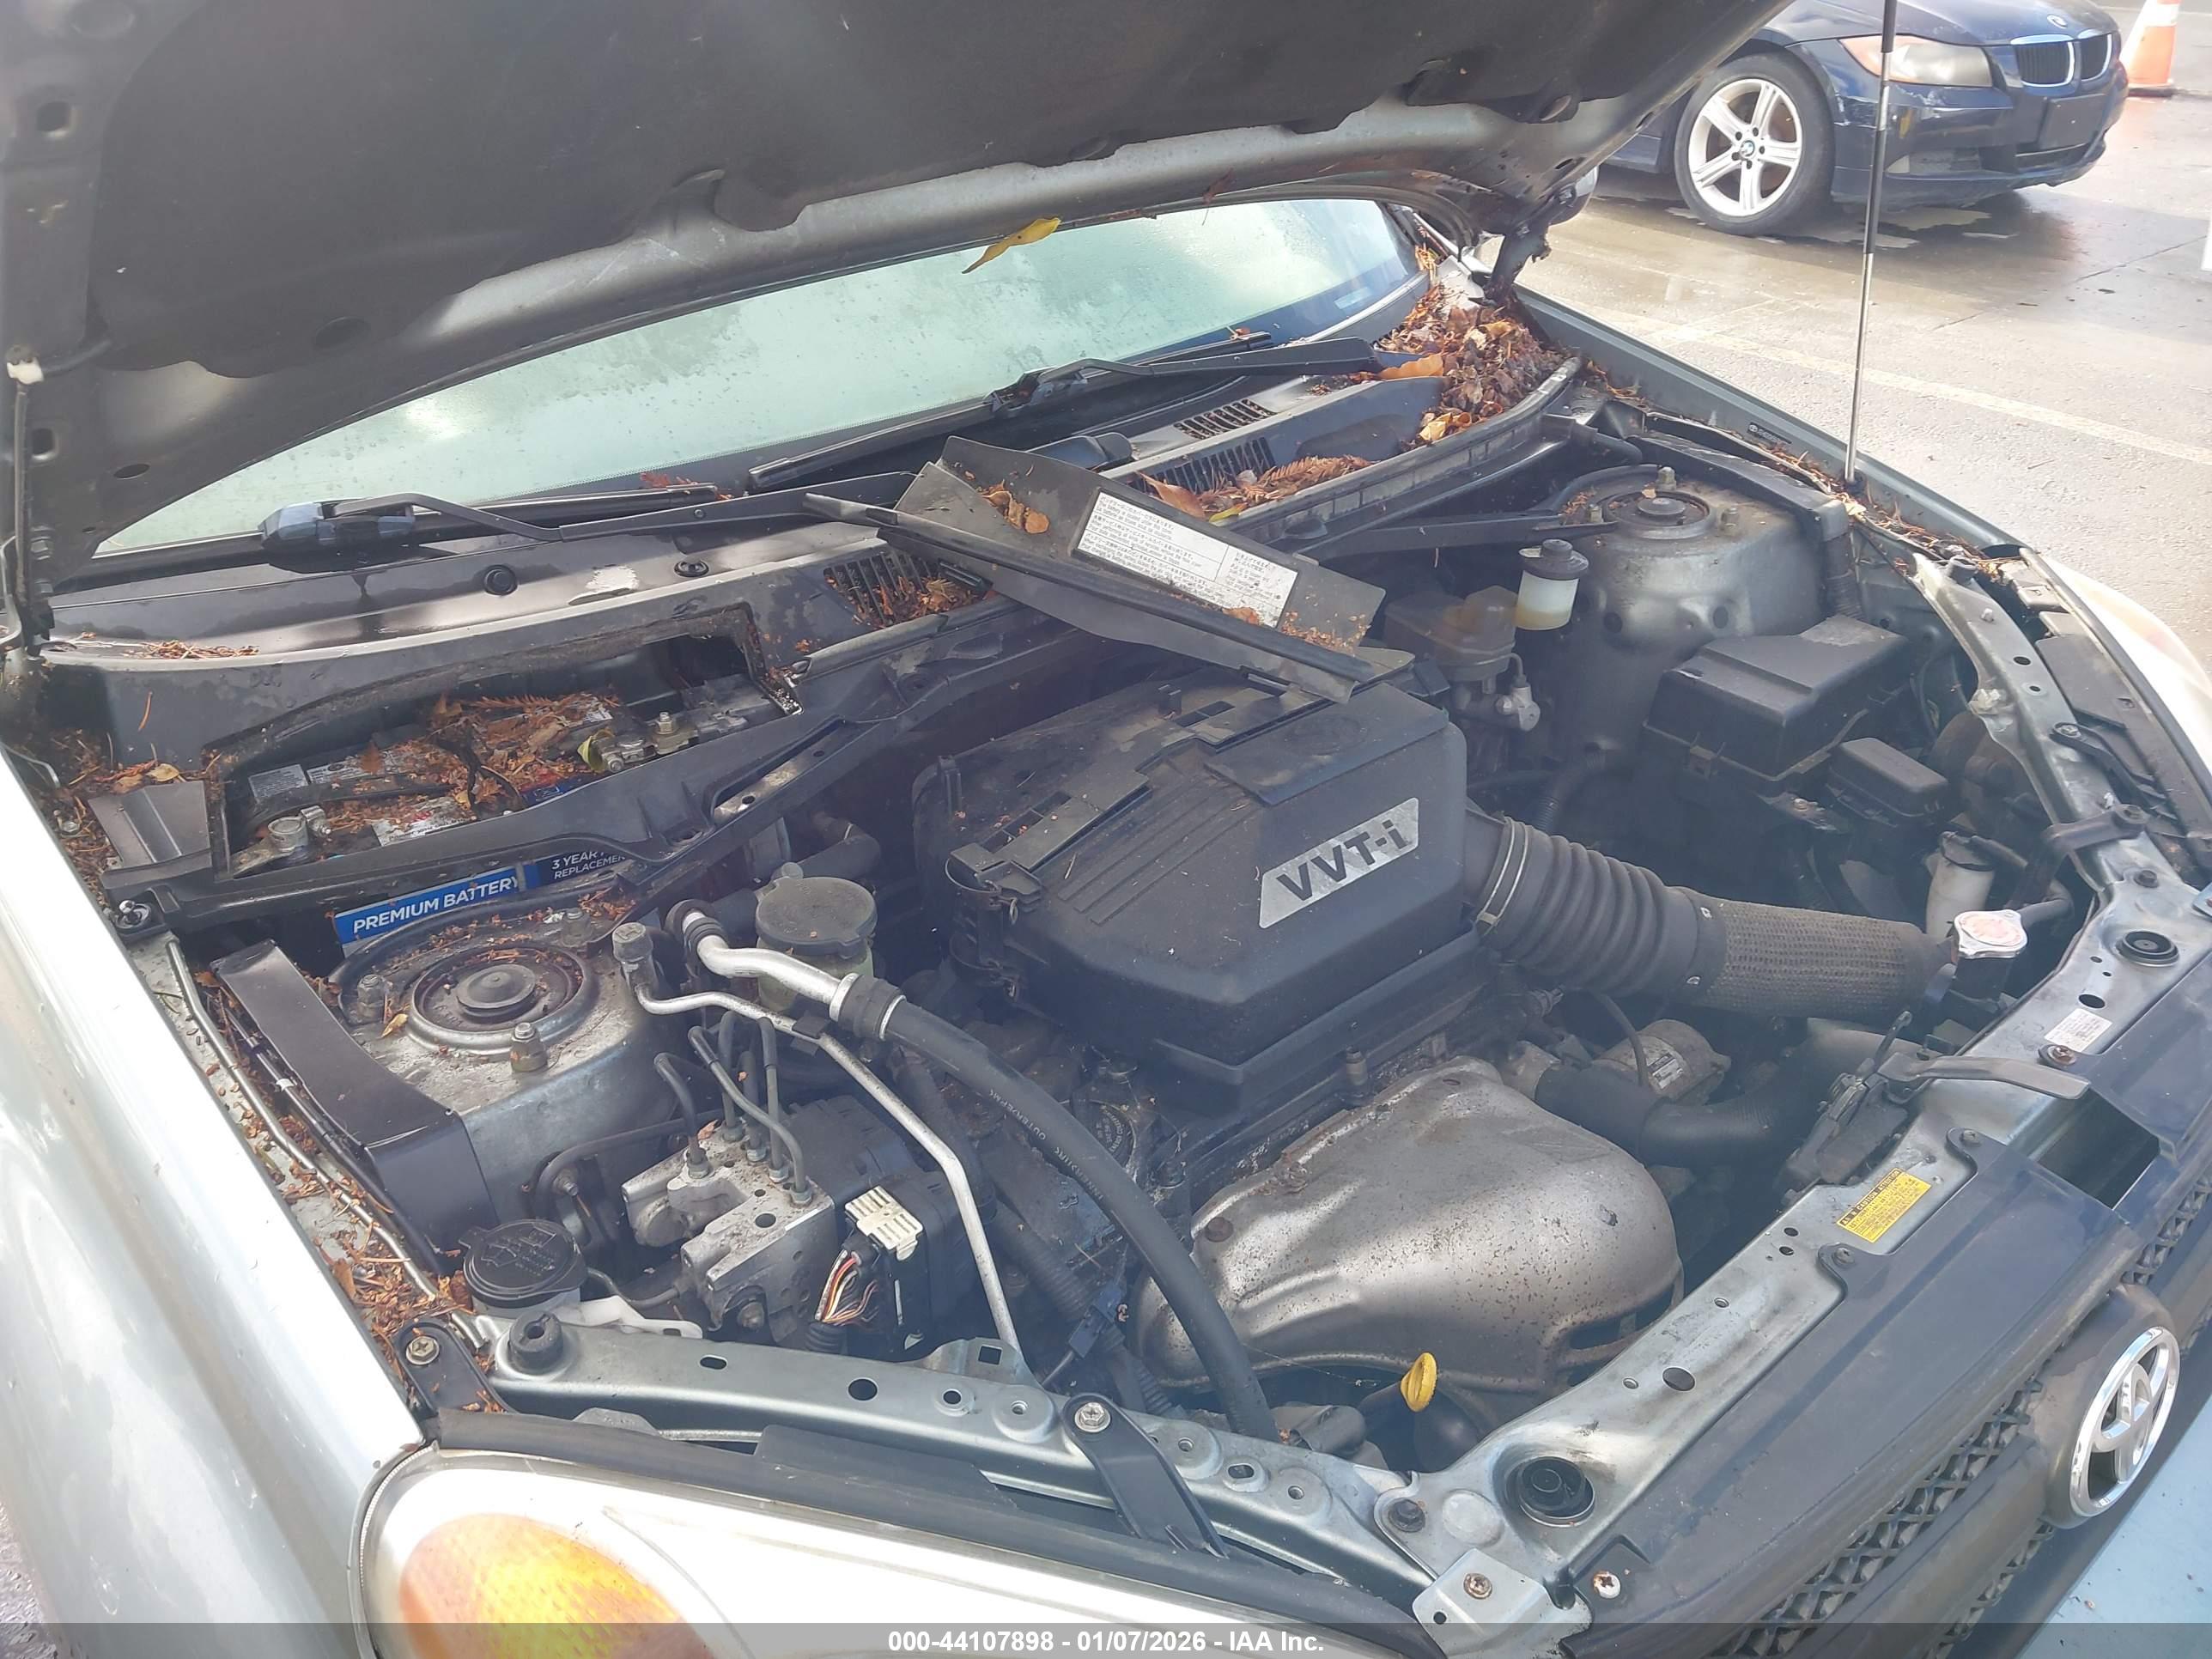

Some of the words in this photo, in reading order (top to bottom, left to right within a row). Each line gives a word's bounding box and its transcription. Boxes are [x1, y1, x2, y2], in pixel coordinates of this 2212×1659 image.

[551, 859, 561, 870] 3
[1276, 819, 1407, 902] VVT-i
[353, 898, 439, 934] PREMIUM
[443, 875, 520, 908] BATTERY
[1856, 1191, 1878, 1210] CAUTION
